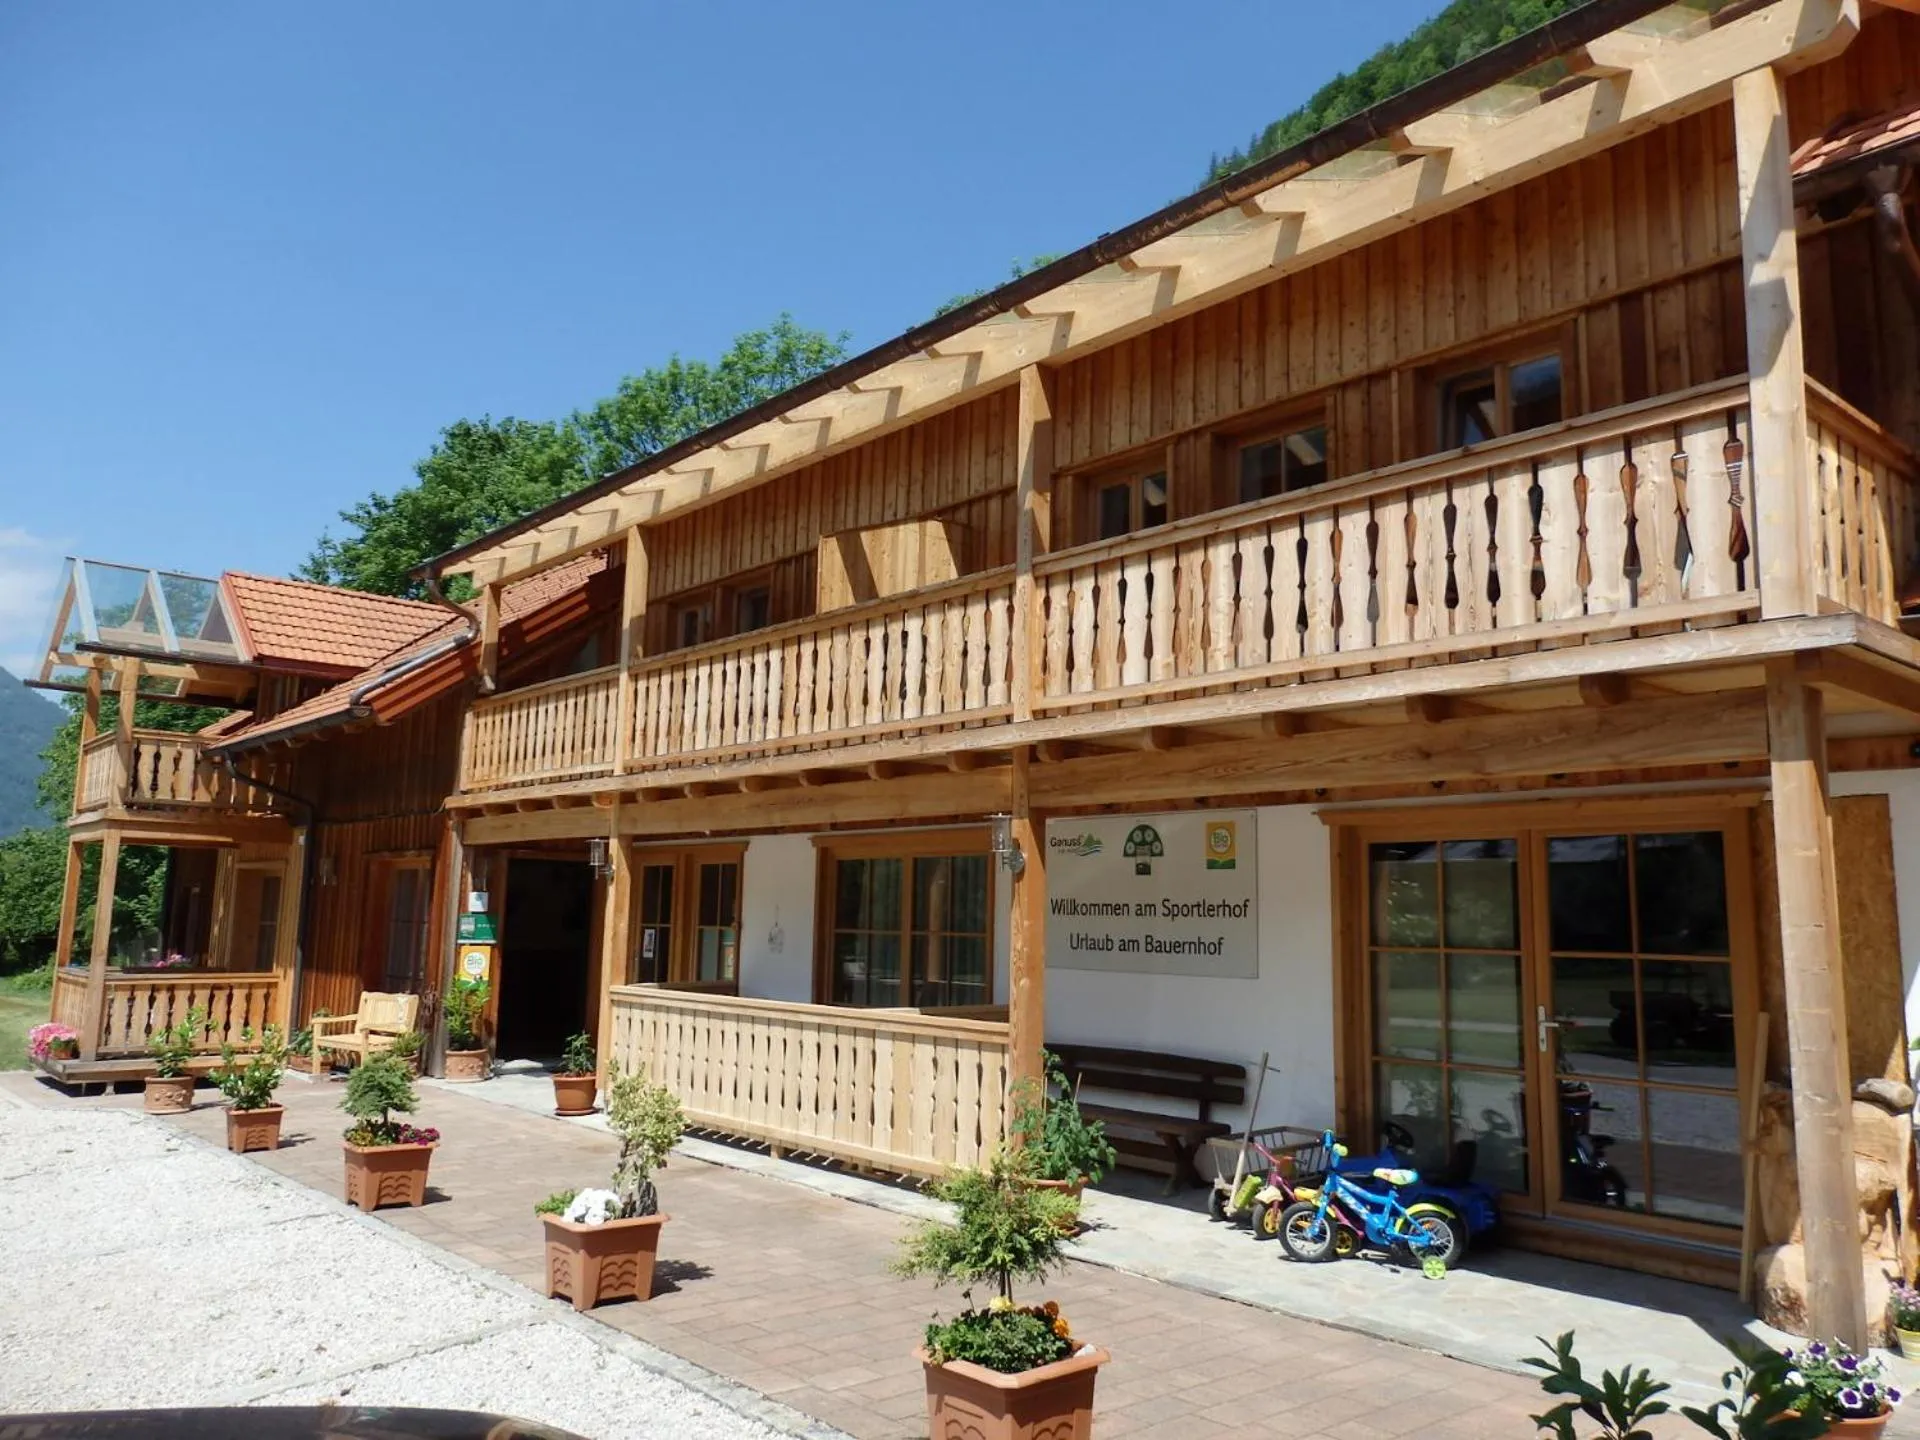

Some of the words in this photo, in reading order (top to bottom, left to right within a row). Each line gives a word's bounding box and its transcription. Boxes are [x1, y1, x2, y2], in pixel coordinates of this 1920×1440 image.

[1050, 898, 1130, 917] Willkommen
[1135, 904, 1157, 917] am
[1161, 899, 1250, 922] Sportlerhof
[1070, 933, 1114, 952] Urlaub
[1118, 938, 1140, 952] am
[1145, 935, 1224, 956] Bauernhof
